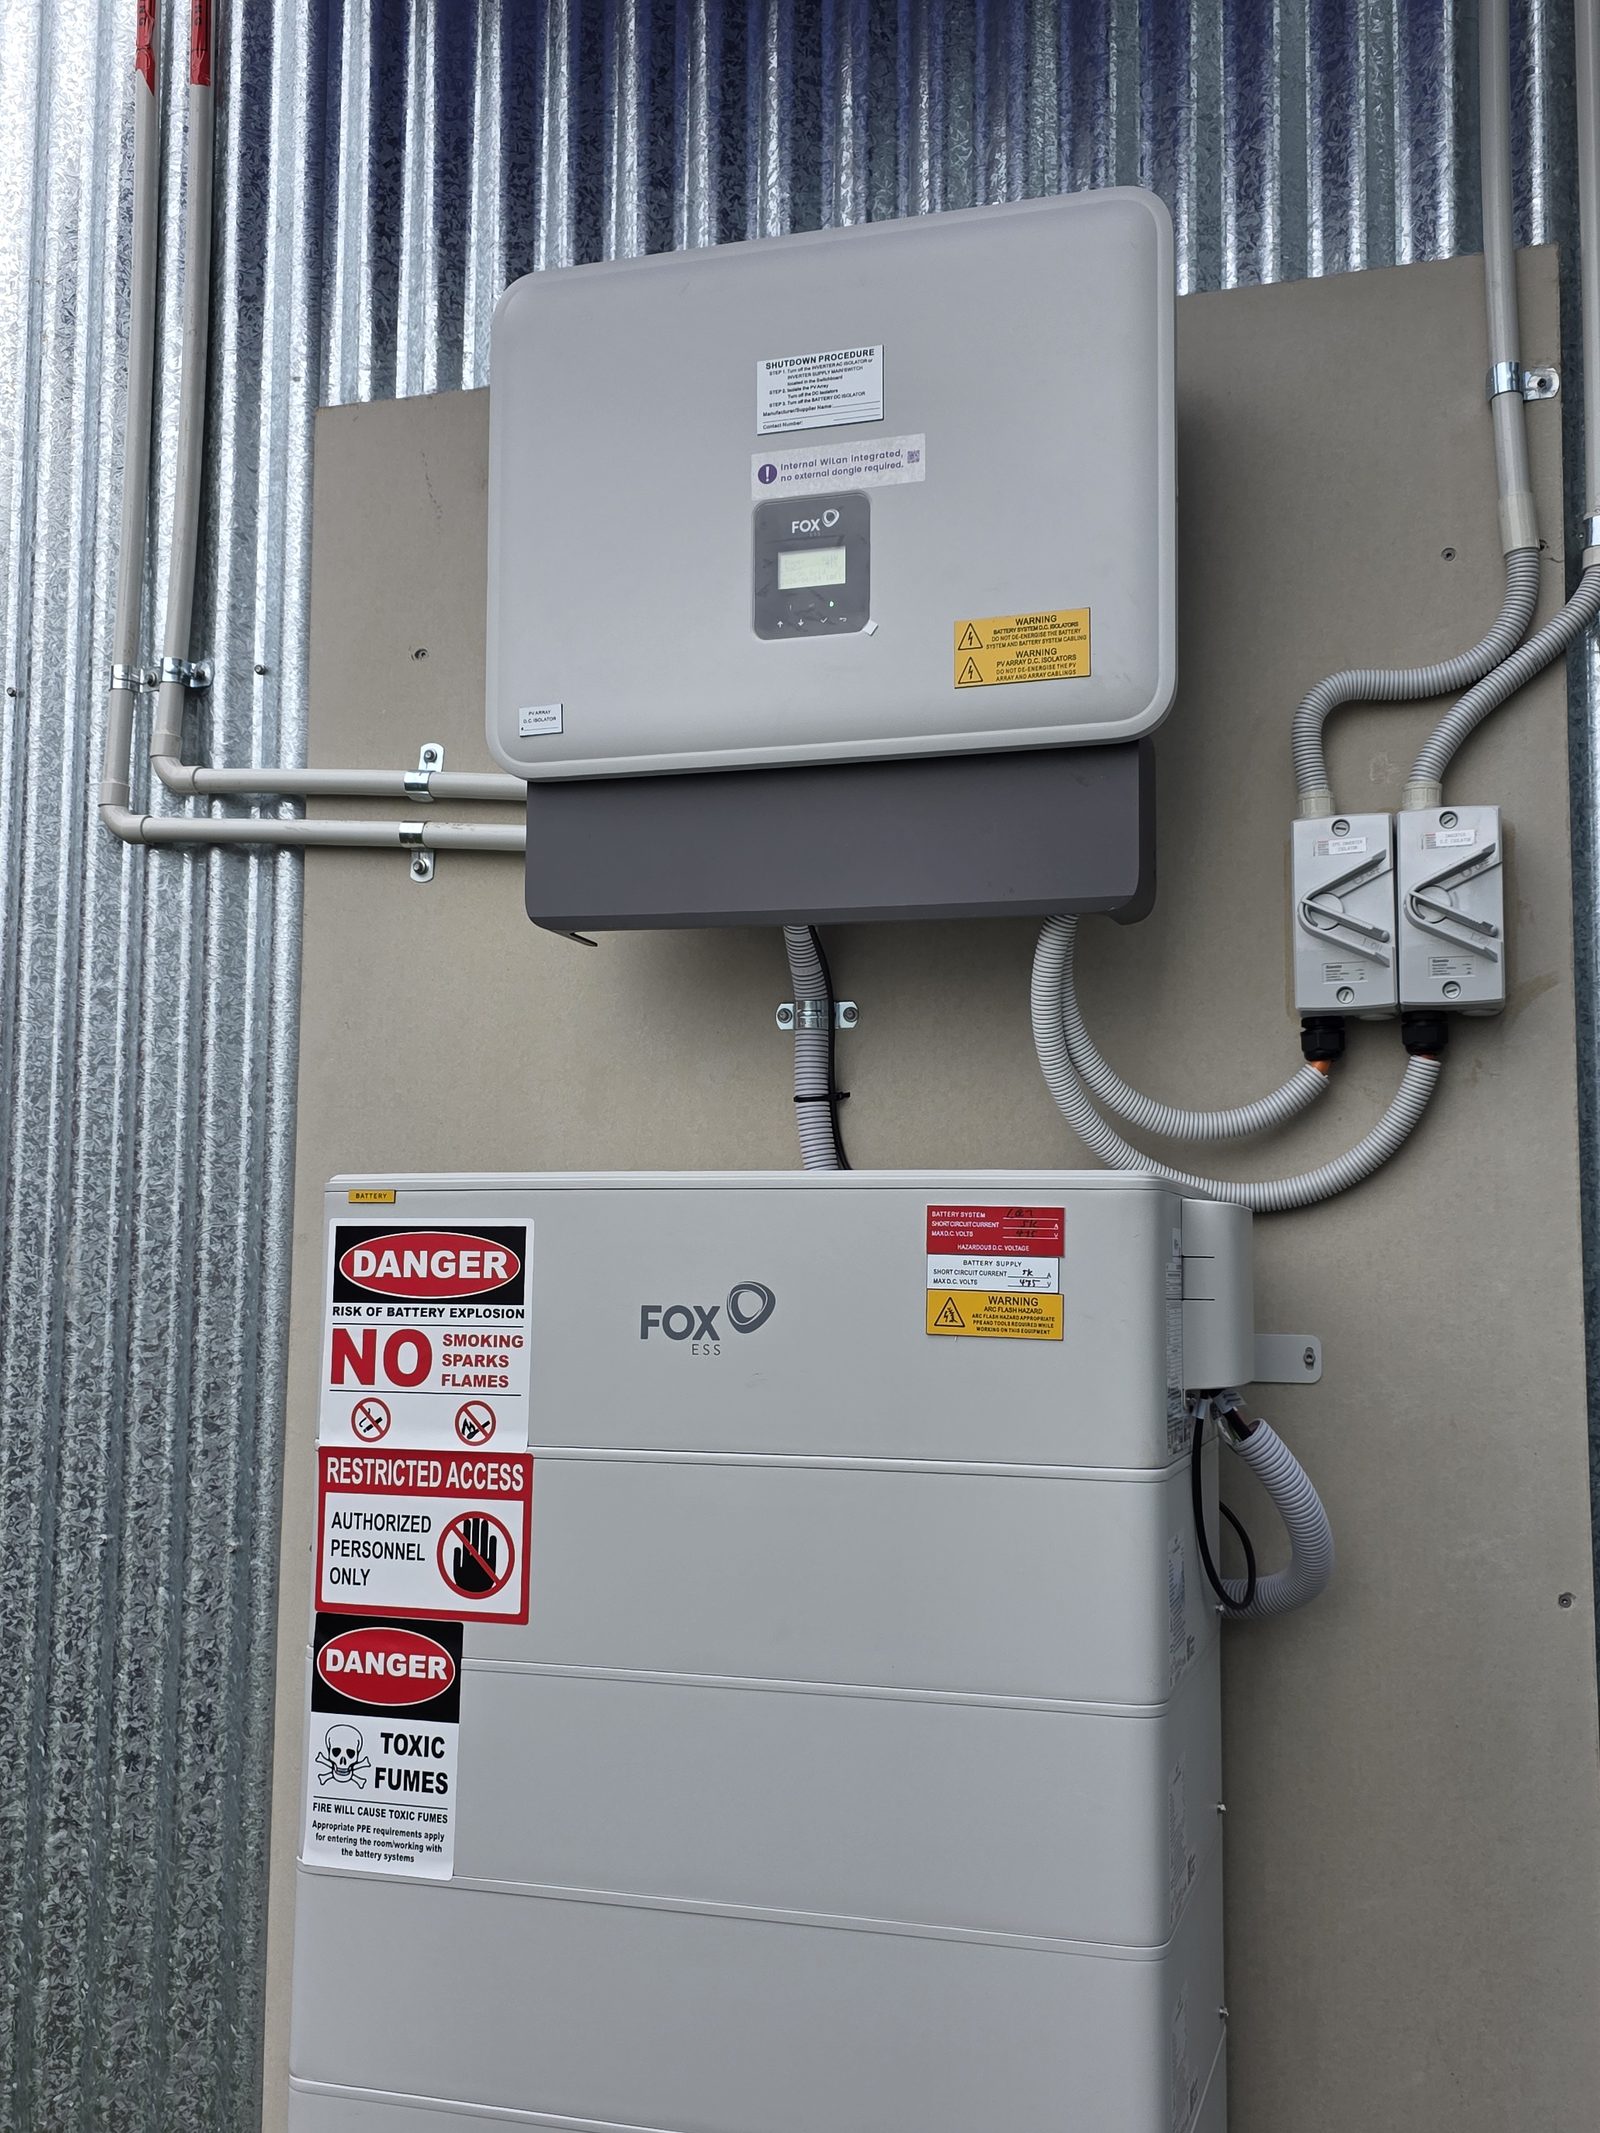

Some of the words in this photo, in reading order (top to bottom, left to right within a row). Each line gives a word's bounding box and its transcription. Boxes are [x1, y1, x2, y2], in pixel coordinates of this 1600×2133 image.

[766, 357, 816, 369] SHUTDOWN
[819, 349, 874, 362] PROCEDURE
[763, 406, 816, 416] Manufacturer/Supplier
[780, 460, 817, 471] Internal
[820, 457, 848, 466] WiLan
[795, 468, 829, 480] external
[832, 464, 862, 476] dongle
[864, 461, 904, 473] required.
[792, 518, 820, 533] FOX
[1015, 615, 1057, 626] WARNING
[1012, 631, 1046, 639] DE-ENERGISE
[1016, 648, 1057, 658] WARNING
[1041, 654, 1076, 663] ISOLATORS
[1018, 664, 1055, 672] DE-ENERGISE
[353, 1250, 508, 1279] DANGER
[1019, 1280, 1040, 1288] 475
[988, 1295, 1039, 1307] WARNING
[332, 1306, 362, 1316] RISK
[366, 1307, 382, 1317] OF
[387, 1307, 445, 1318] BATTERY
[449, 1308, 525, 1319] EXPLOSION
[640, 1305, 720, 1341] FOX
[442, 1334, 524, 1348] SMOKING
[692, 1344, 721, 1355] ESS
[330, 1328, 432, 1387] NO
[442, 1354, 509, 1368] SPARKS
[441, 1374, 509, 1388] FLAMES
[327, 1457, 442, 1488] RESTRICTED
[446, 1461, 524, 1491] ACCESS
[331, 1512, 431, 1533] AUTHORIZED
[331, 1539, 425, 1561] PERSONNEL
[330, 1567, 370, 1586] ONLY
[326, 1648, 447, 1680] DANGER
[380, 1732, 445, 1759] TOXIC
[375, 1767, 448, 1795] FUMES
[313, 1802, 331, 1813] FIRE
[334, 1804, 354, 1815] WILL
[357, 1806, 386, 1818] CAUSE
[389, 1809, 415, 1820] TOXIC
[418, 1812, 448, 1824] FUMES
[312, 1820, 354, 1832] Appropriate
[357, 1824, 371, 1833] PPE
[373, 1827, 422, 1838] requirements
[424, 1832, 444, 1842] apply
[316, 1832, 325, 1841] for
[327, 1835, 357, 1846] entering
[360, 1837, 372, 1846] the
[374, 1839, 424, 1853] room/working
[426, 1844, 442, 1852] with
[342, 1848, 353, 1856] the
[355, 1849, 382, 1861] battery
[384, 1852, 415, 1863] systems
